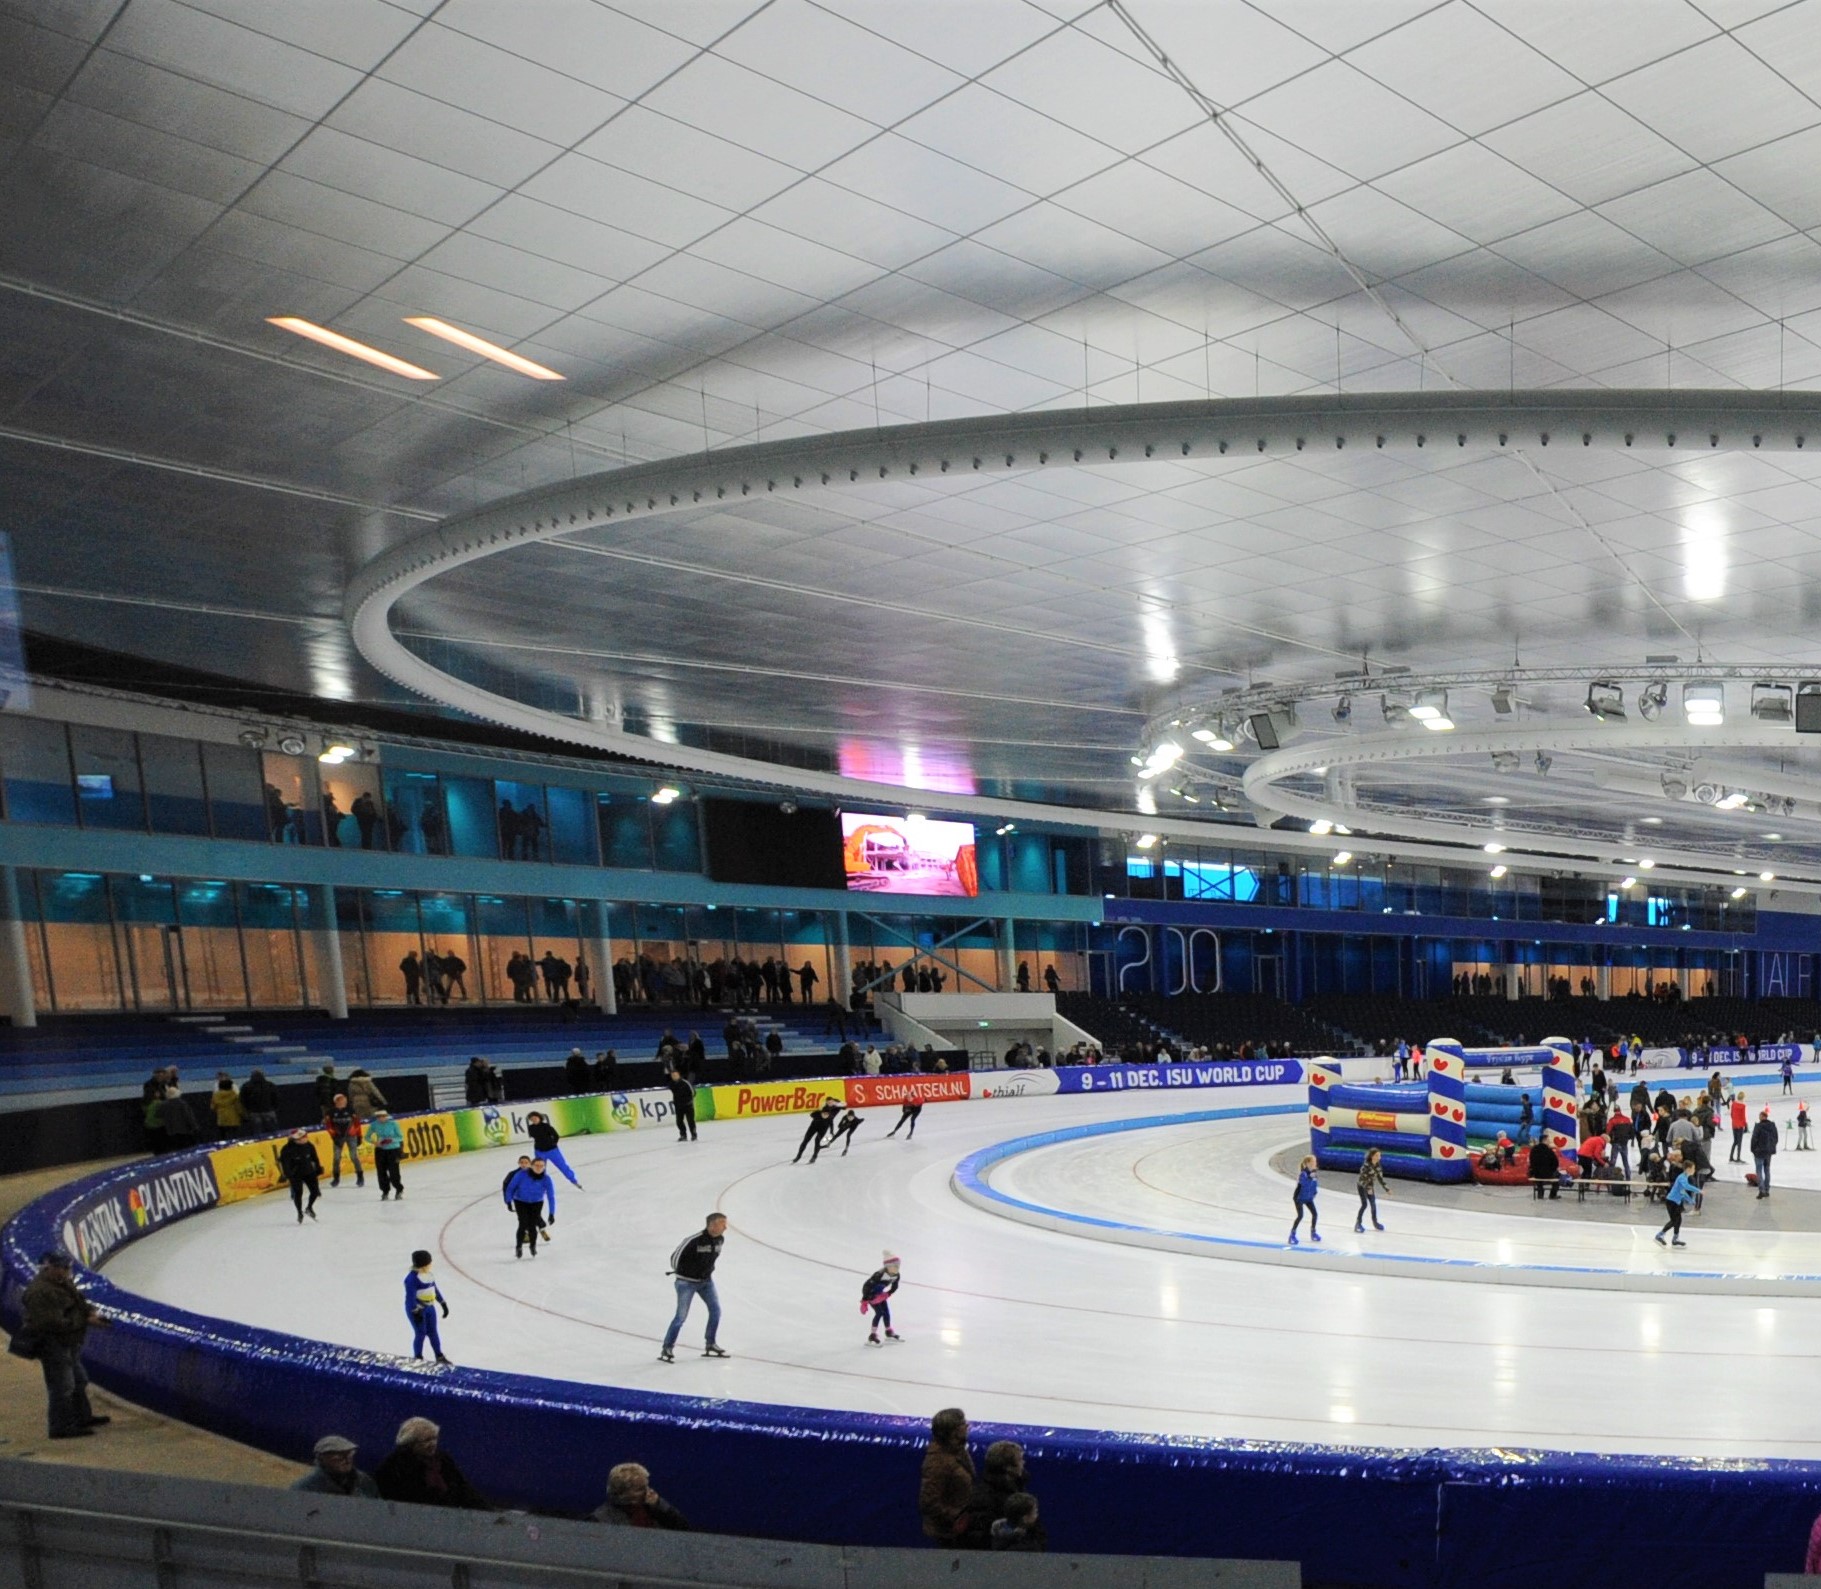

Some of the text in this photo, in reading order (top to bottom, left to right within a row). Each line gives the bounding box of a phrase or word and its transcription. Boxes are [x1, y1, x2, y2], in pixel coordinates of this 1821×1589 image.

[875, 1080, 968, 1101] SCHAATSEN.NL
[1081, 1072, 1093, 1090] 9
[1109, 1071, 1124, 1089] 11
[1127, 1069, 1163, 1087] DEC.
[1166, 1067, 1192, 1086] ISU
[1195, 1065, 1251, 1084] WORLD
[1255, 1064, 1285, 1081] CUP
[737, 1086, 826, 1115] PowerBar
[400, 1120, 452, 1160] otto.
[138, 1166, 217, 1225] PLANTINA
